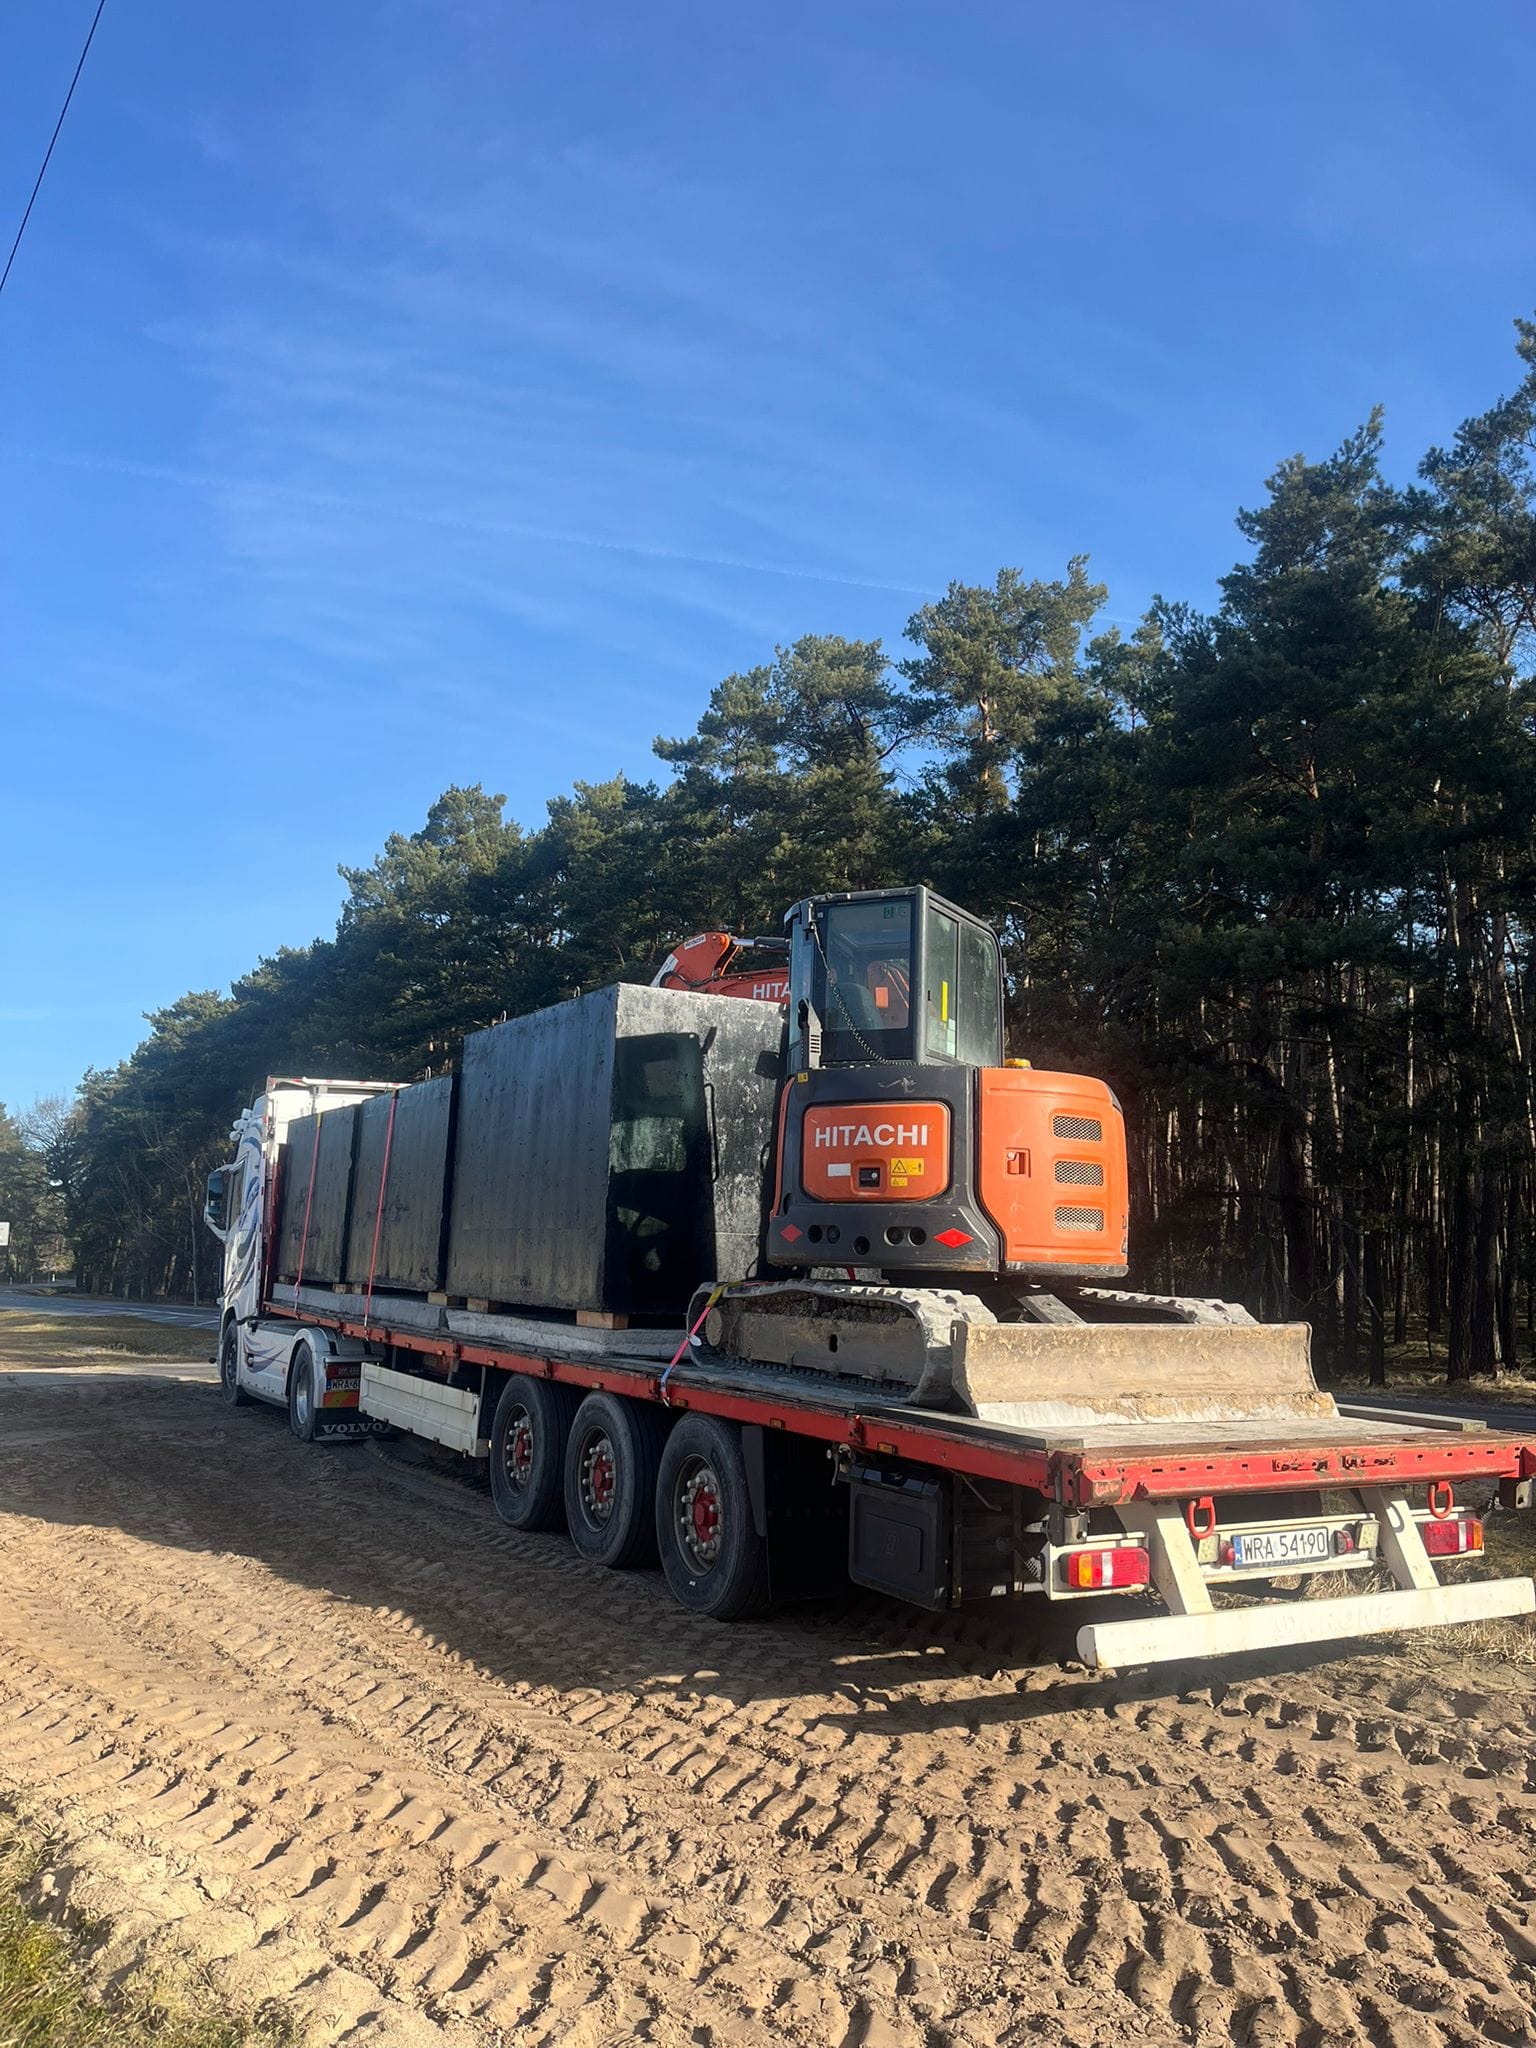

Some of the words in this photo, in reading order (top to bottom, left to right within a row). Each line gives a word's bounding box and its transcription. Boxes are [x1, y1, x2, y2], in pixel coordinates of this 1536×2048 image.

[815, 1124, 928, 1148] HITACHI
[321, 1423, 384, 1433] VOLVO
[1243, 1537, 1275, 1560] WRA
[1279, 1532, 1325, 1557] 54190
